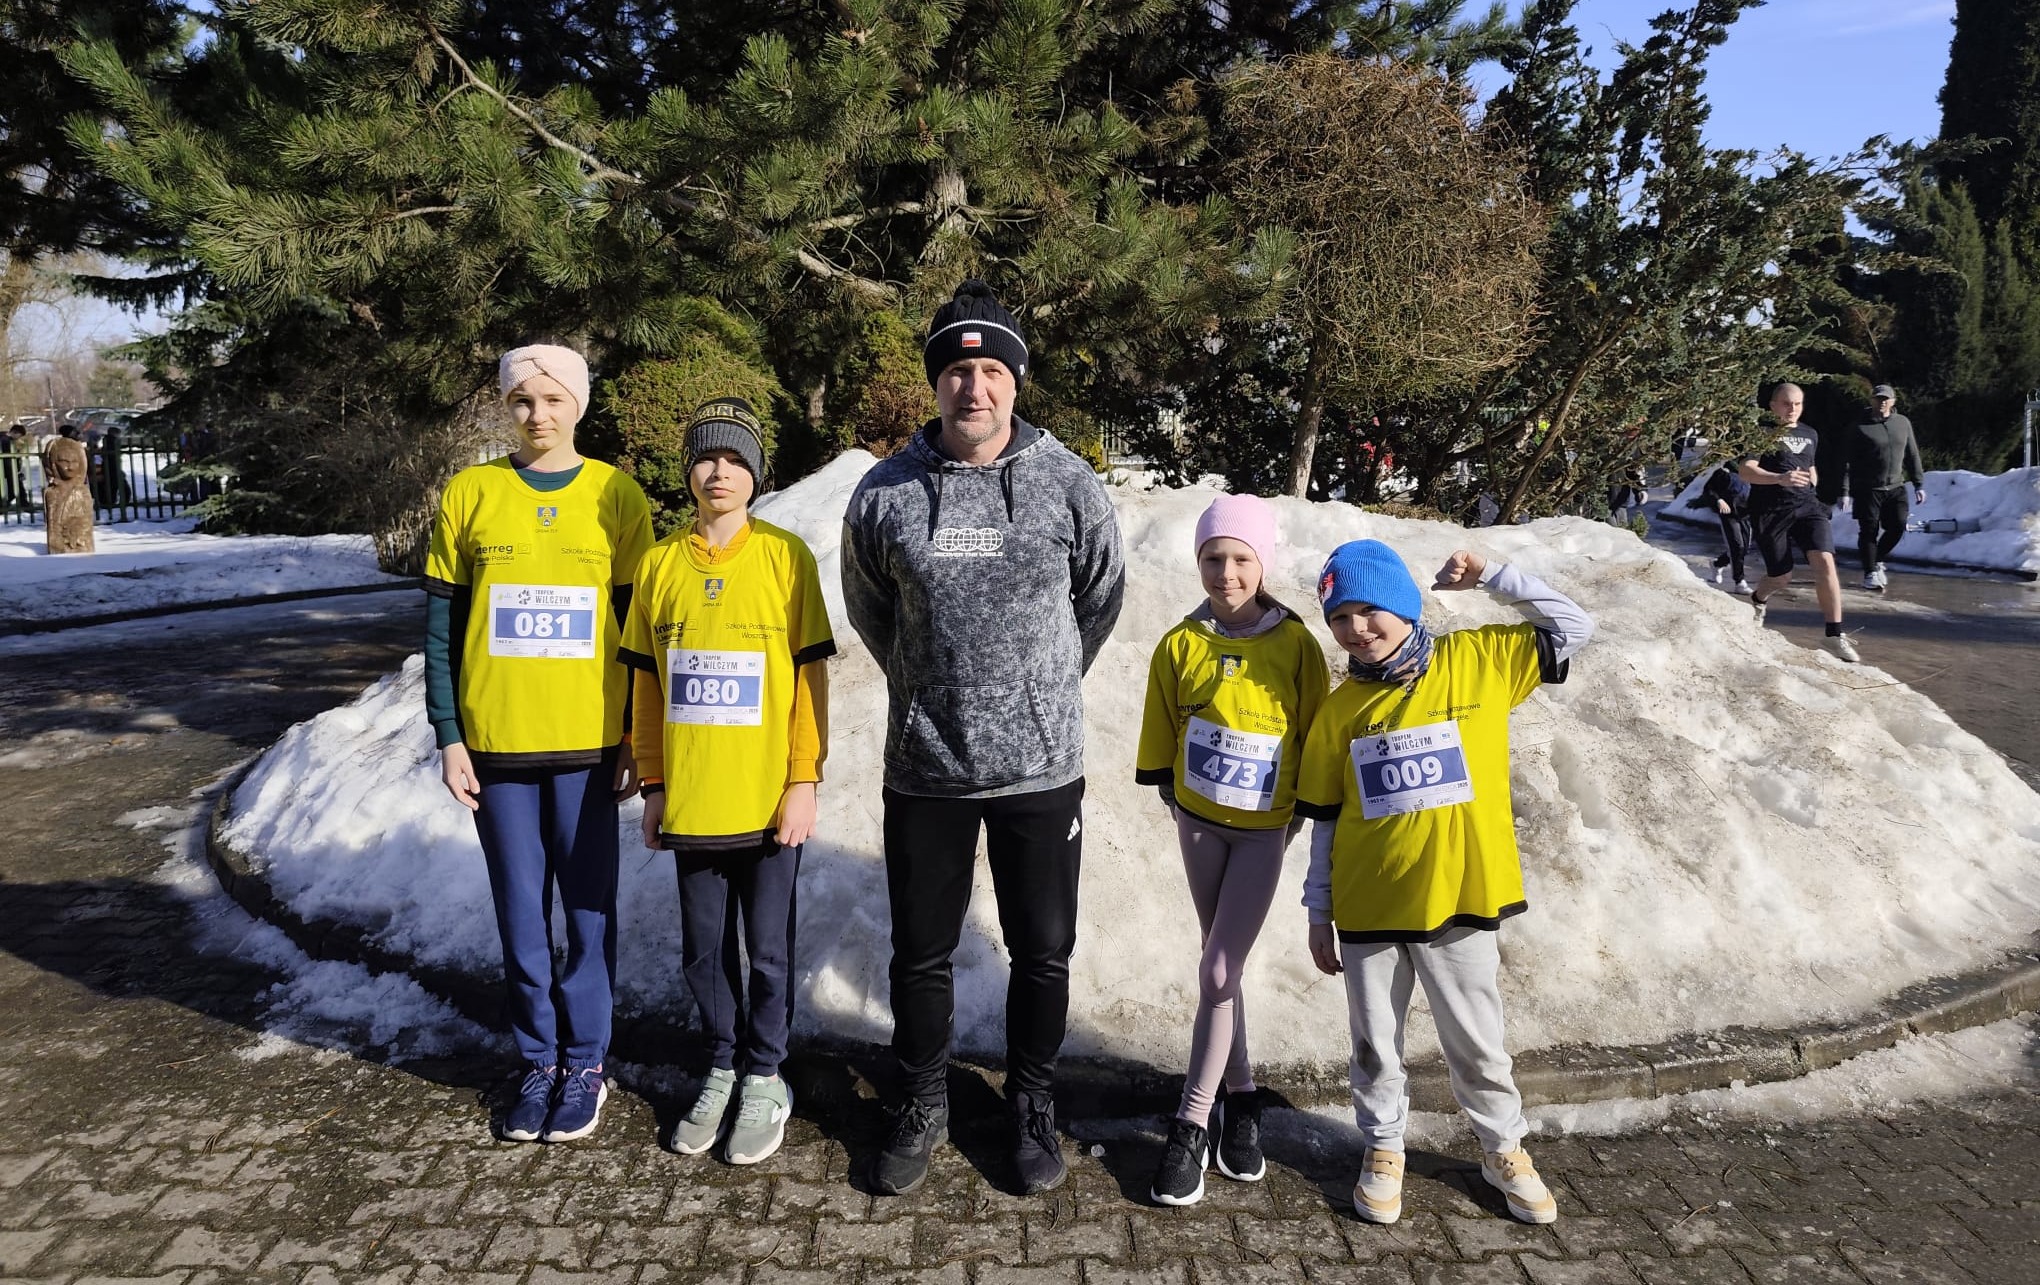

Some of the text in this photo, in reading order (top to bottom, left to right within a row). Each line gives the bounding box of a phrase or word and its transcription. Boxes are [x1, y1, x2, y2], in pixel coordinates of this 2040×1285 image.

[535, 595, 571, 604] WILCZYM
[514, 612, 571, 638] 081
[703, 660, 738, 670] WILCZYM
[685, 677, 740, 705] 080
[1225, 739, 1260, 753] WILCZYM
[1393, 735, 1433, 752] WILCZYM
[1202, 754, 1258, 788] 473
[1380, 755, 1443, 791] 009
